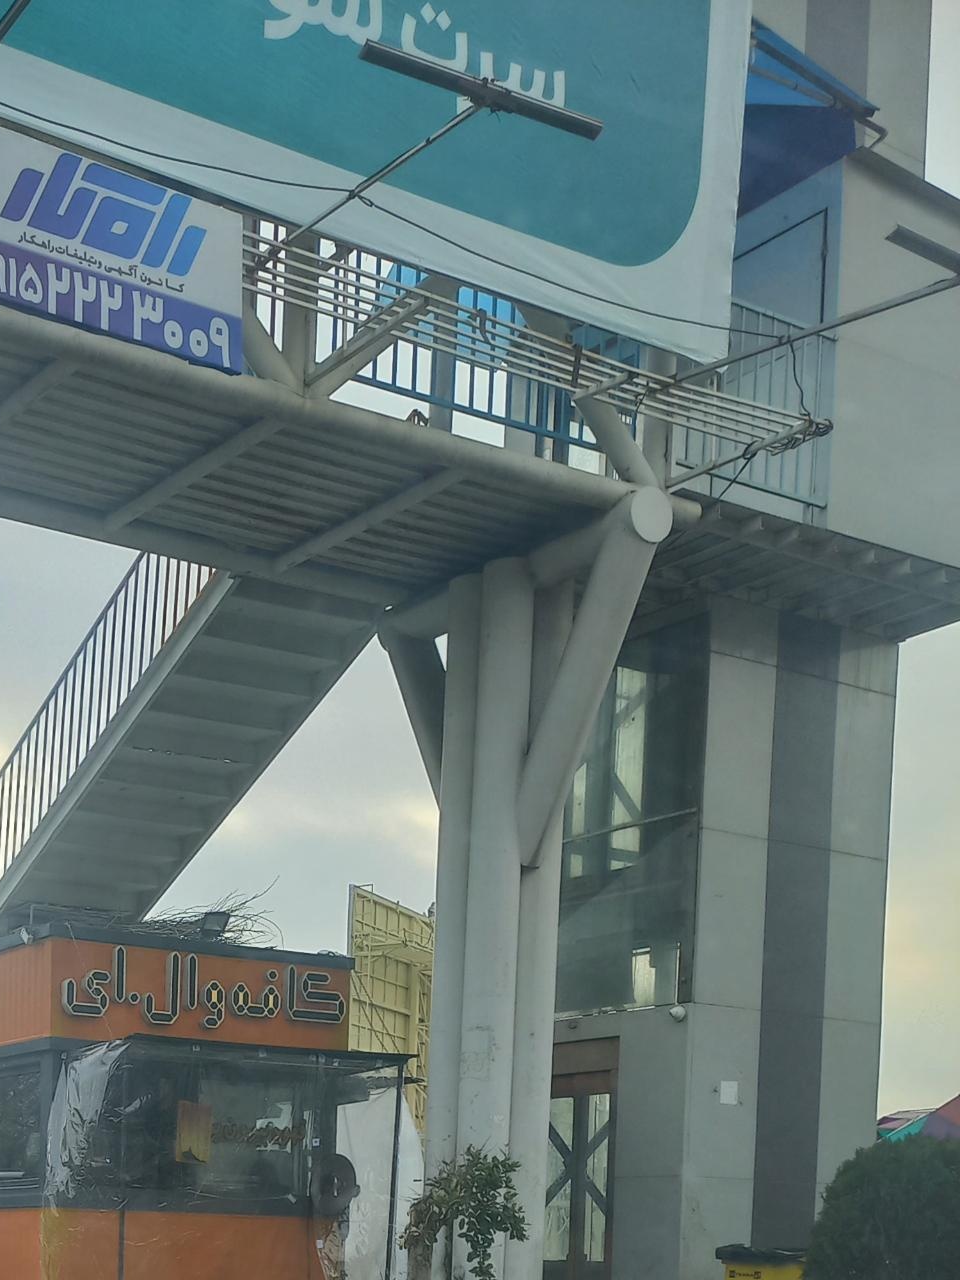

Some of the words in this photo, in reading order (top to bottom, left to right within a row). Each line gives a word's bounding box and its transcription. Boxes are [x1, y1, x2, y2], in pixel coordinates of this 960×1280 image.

[18, 231, 55, 253] راهکار
[104, 264, 138, 279] آگهی
[140, 272, 185, 293] کانون
[232, 965, 345, 1023] کافه
